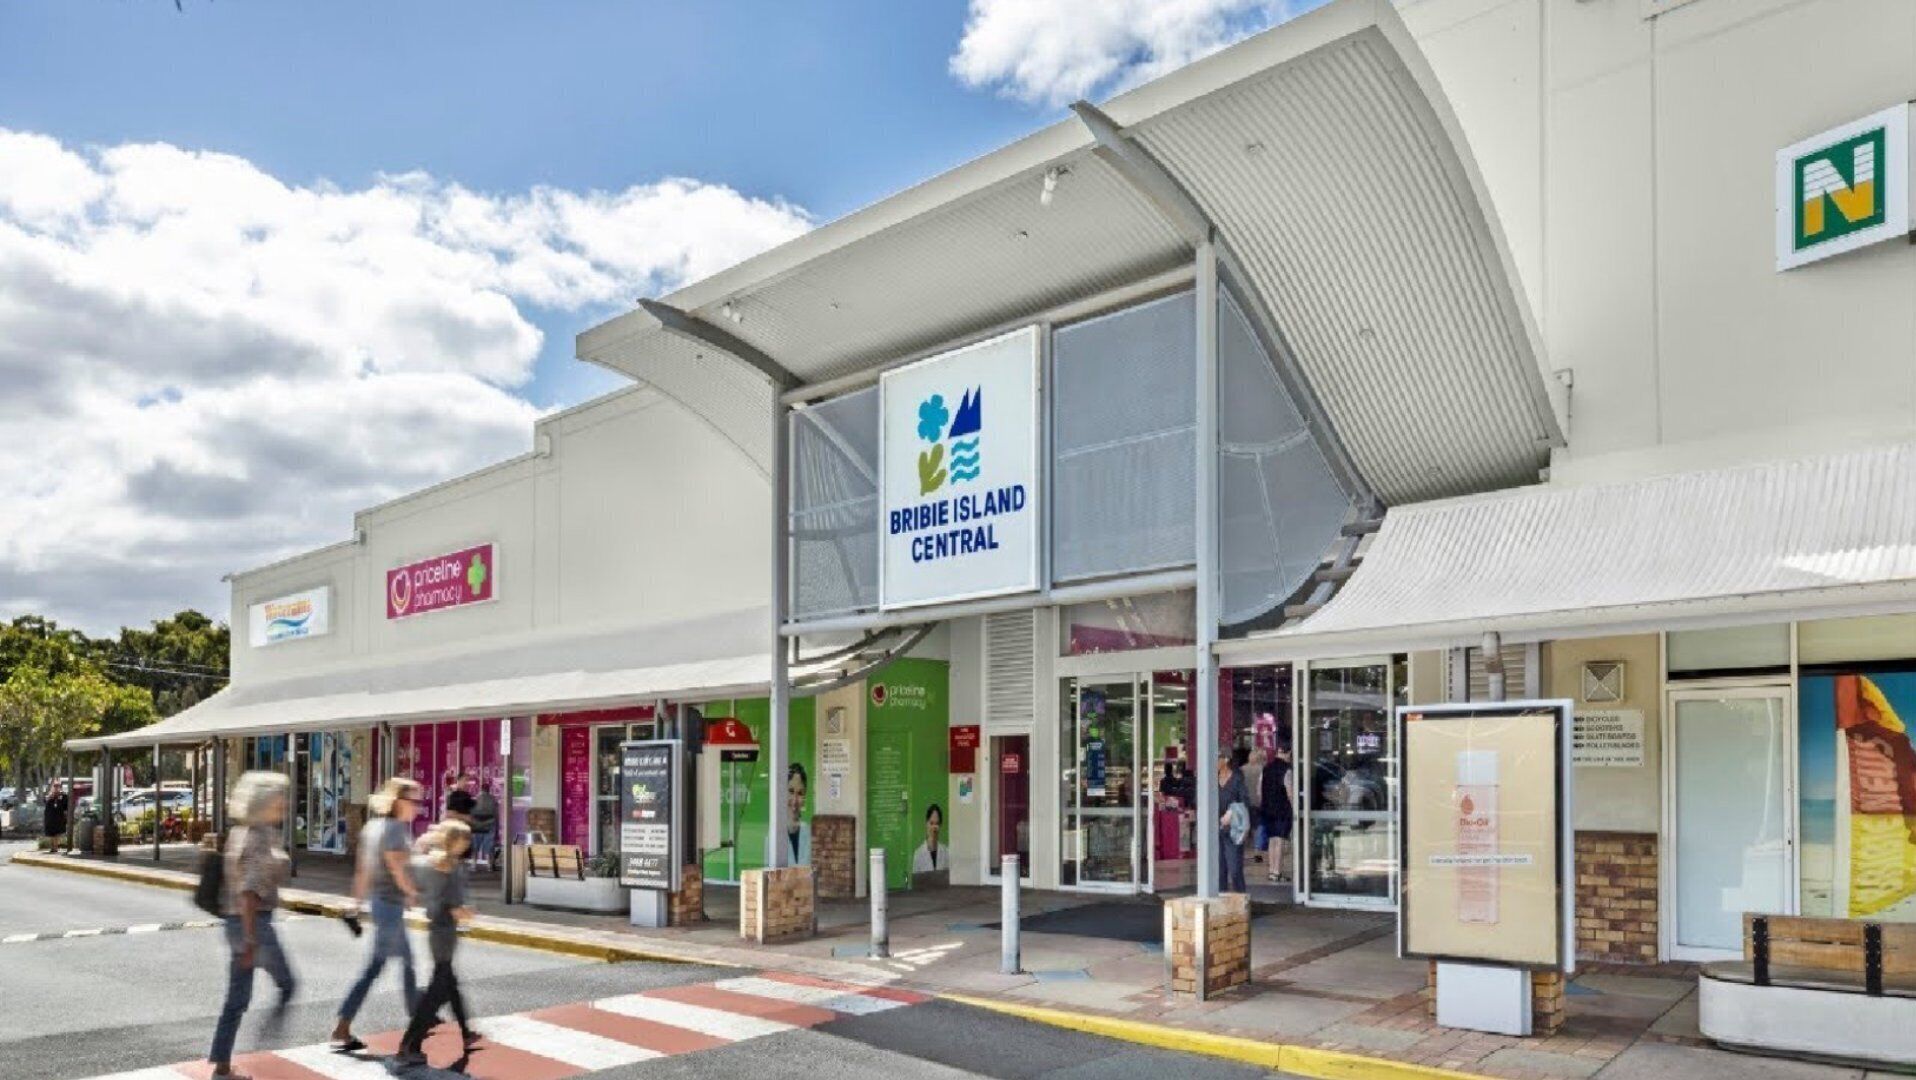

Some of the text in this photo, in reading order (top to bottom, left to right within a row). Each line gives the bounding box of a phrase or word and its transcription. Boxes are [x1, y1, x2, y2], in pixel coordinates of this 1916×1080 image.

[890, 484, 1026, 535] BRIBIE ISLAND
[911, 523, 999, 563] CENTRAL
[414, 560, 462, 592] priceline
[414, 585, 462, 612] pharmacy
[889, 684, 926, 698] priceline
[889, 698, 926, 710] pharmacy
